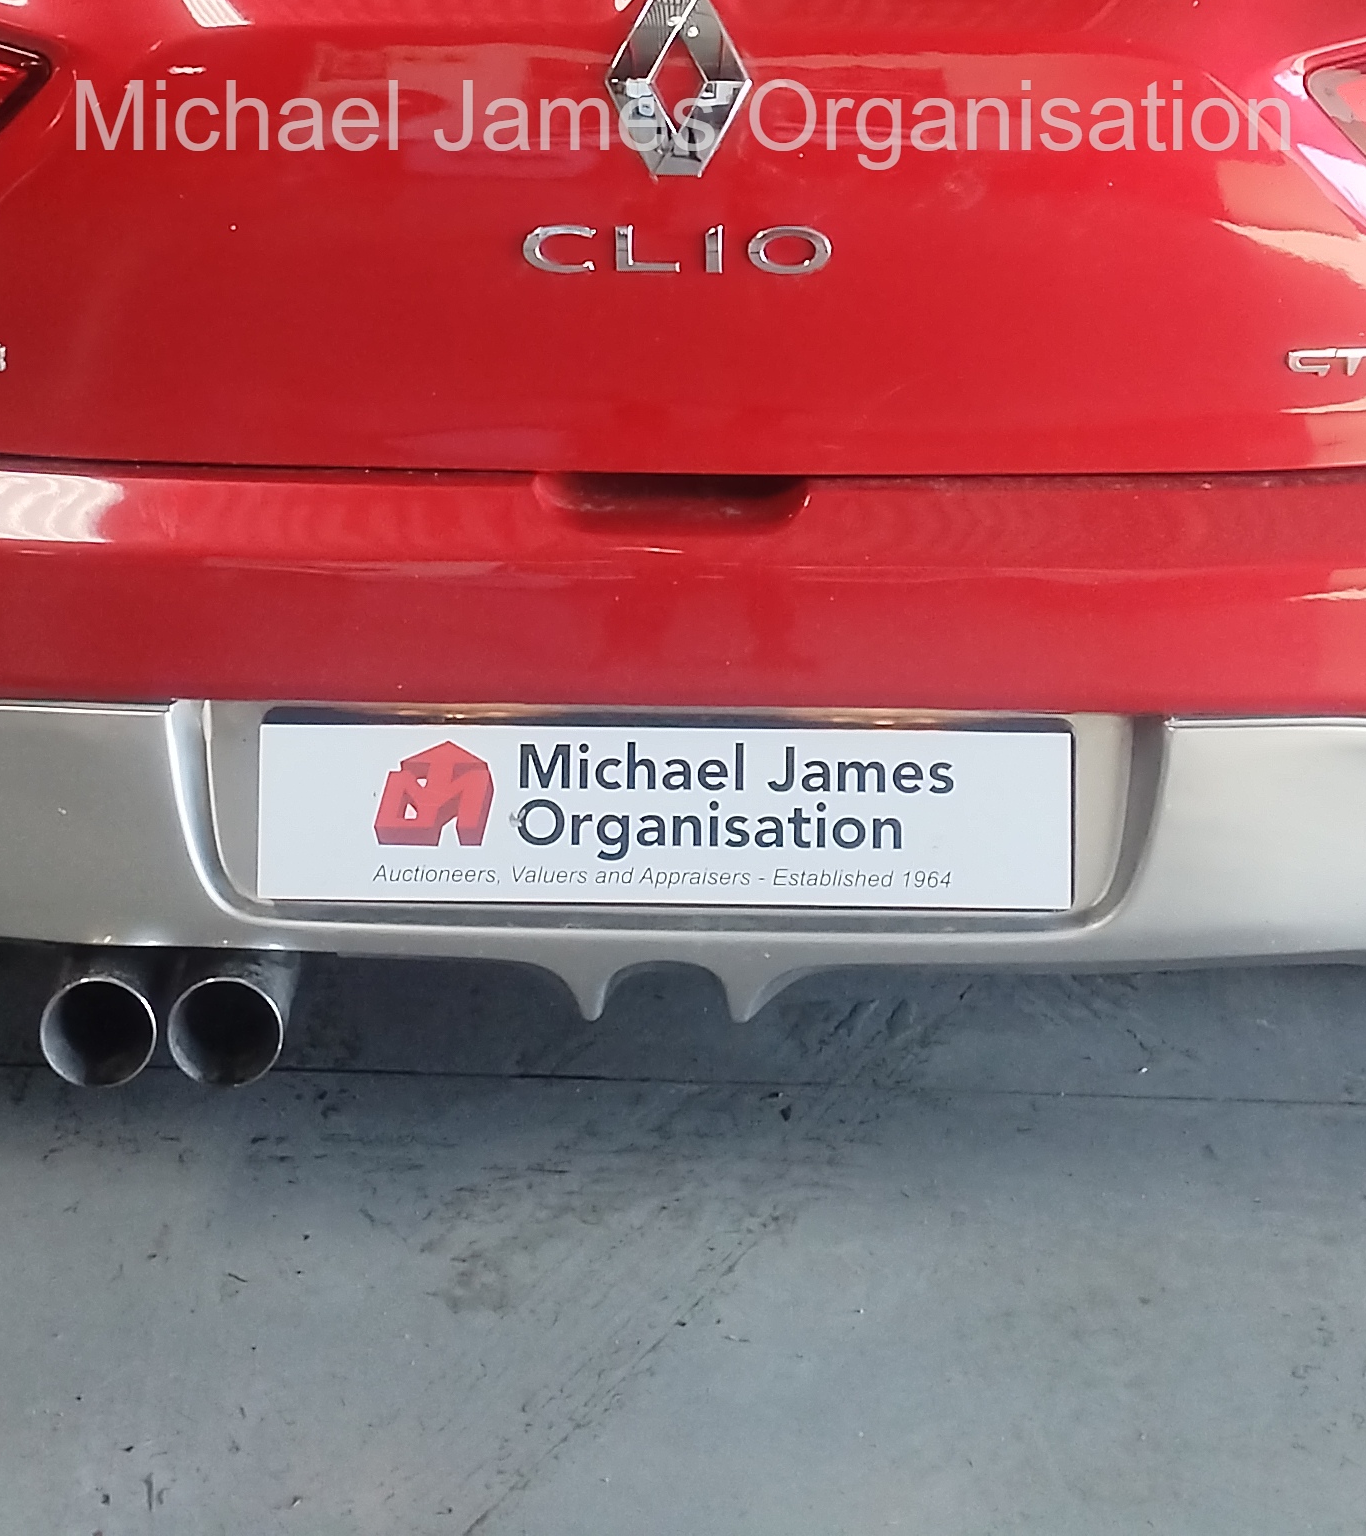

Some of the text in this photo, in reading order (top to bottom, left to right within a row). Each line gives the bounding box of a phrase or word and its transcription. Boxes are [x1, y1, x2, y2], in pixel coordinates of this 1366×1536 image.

[523, 224, 832, 275] CLIO
[520, 742, 953, 793] Michael James
[520, 798, 904, 860] Organisation
[373, 864, 501, 886] Auctioneers,
[513, 866, 587, 883] Valuers
[595, 867, 634, 883] and
[639, 868, 750, 888] Appraisers
[774, 869, 893, 887] Established
[904, 871, 950, 888] 1964
